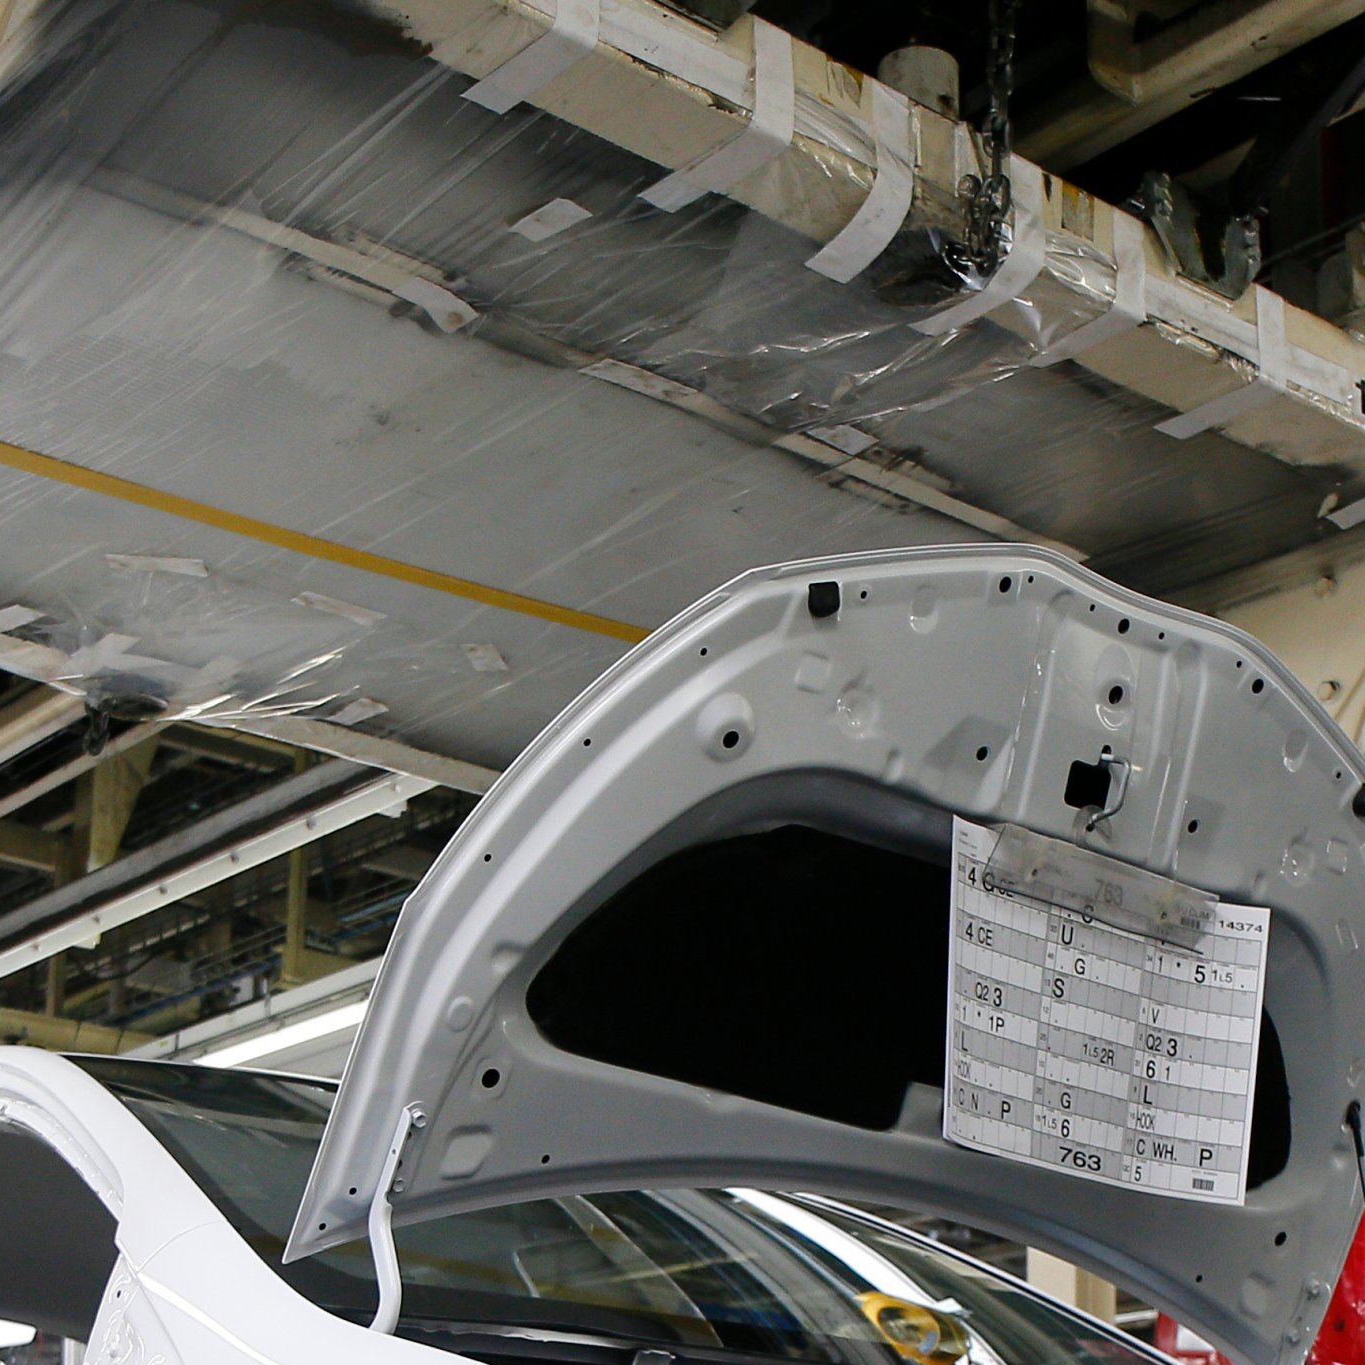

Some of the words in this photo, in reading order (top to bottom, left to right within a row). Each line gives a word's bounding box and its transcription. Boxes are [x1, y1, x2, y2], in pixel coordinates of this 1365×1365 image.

[967, 866, 977, 886] 4
[965, 921, 974, 941] 4
[977, 926, 993, 947] CE
[1061, 923, 1074, 945] U
[1218, 919, 1264, 934] 14374
[1074, 957, 1086, 975] G
[1157, 955, 1164, 973] 1
[1194, 964, 1206, 984] 5
[975, 981, 989, 1001] Q2
[992, 987, 1002, 1007] 3
[1052, 977, 1065, 999] S
[989, 1015, 1005, 1032] 1P
[1151, 1008, 1161, 1024] V
[961, 1030, 969, 1052] L
[1145, 1033, 1163, 1052] Q2
[1166, 1038, 1178, 1057] 3
[1145, 1059, 1157, 1079] 6
[1164, 1066, 1171, 1081] 1
[957, 1087, 966, 1106] C
[971, 1092, 980, 1111] N
[1001, 1100, 1012, 1120] P
[1059, 1091, 1072, 1110] G
[1143, 1085, 1153, 1105] L
[1060, 1118, 1071, 1138] 6
[1136, 1112, 1156, 1132] HOOK
[1058, 1145, 1102, 1172] 763
[1135, 1138, 1146, 1156] C
[1198, 1148, 1214, 1167] P
[1133, 1165, 1143, 1183] 5
